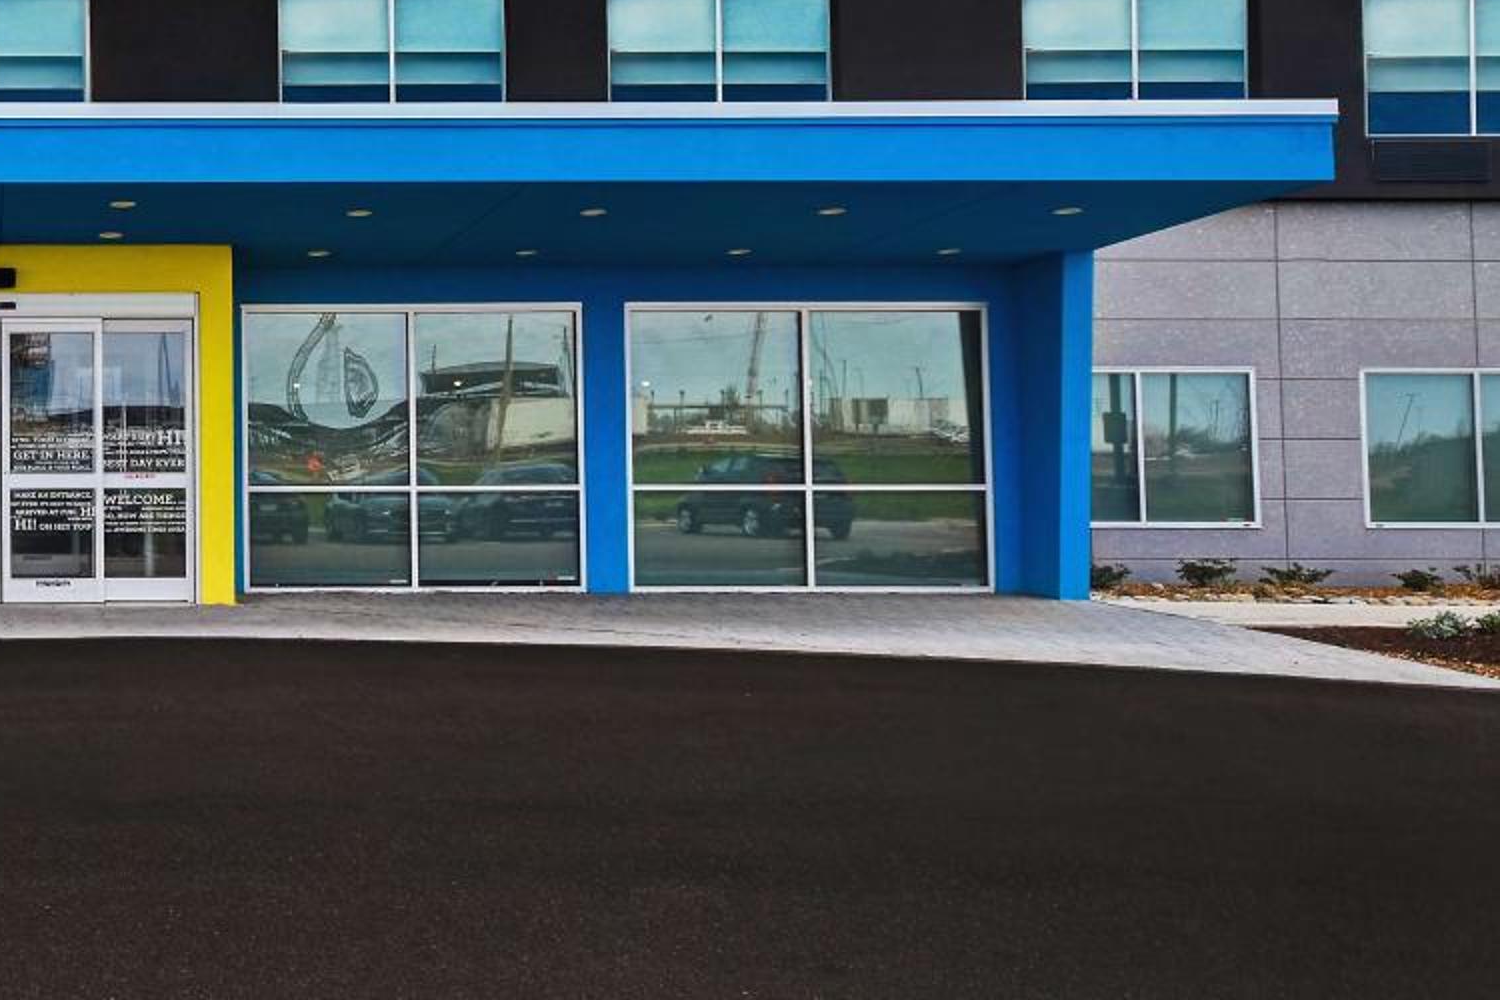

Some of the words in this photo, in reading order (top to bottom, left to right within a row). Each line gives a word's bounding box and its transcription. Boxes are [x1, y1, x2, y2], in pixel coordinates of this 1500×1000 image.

[13, 450, 37, 460] GET
[40, 450, 54, 460] IN
[130, 459, 154, 468] DAY
